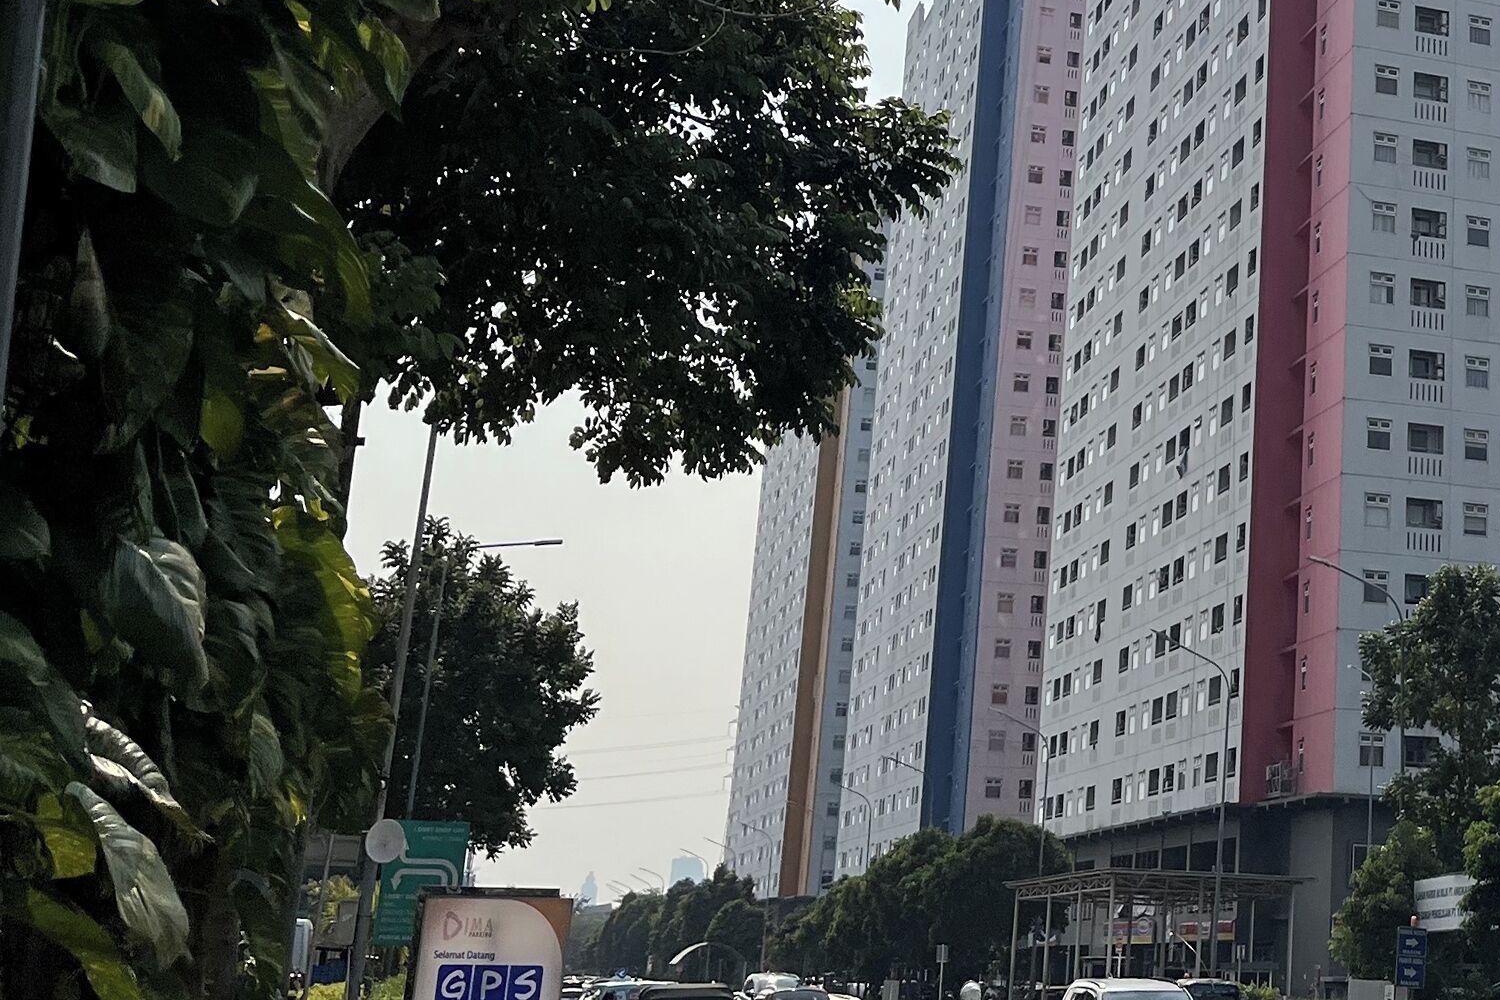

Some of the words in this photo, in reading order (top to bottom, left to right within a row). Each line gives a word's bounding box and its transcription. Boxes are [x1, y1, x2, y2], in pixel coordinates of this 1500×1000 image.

[442, 911, 494, 941] DIMA
[433, 950, 465, 960] Selamat
[466, 950, 496, 961] Datang
[440, 969, 537, 1000] GPS
